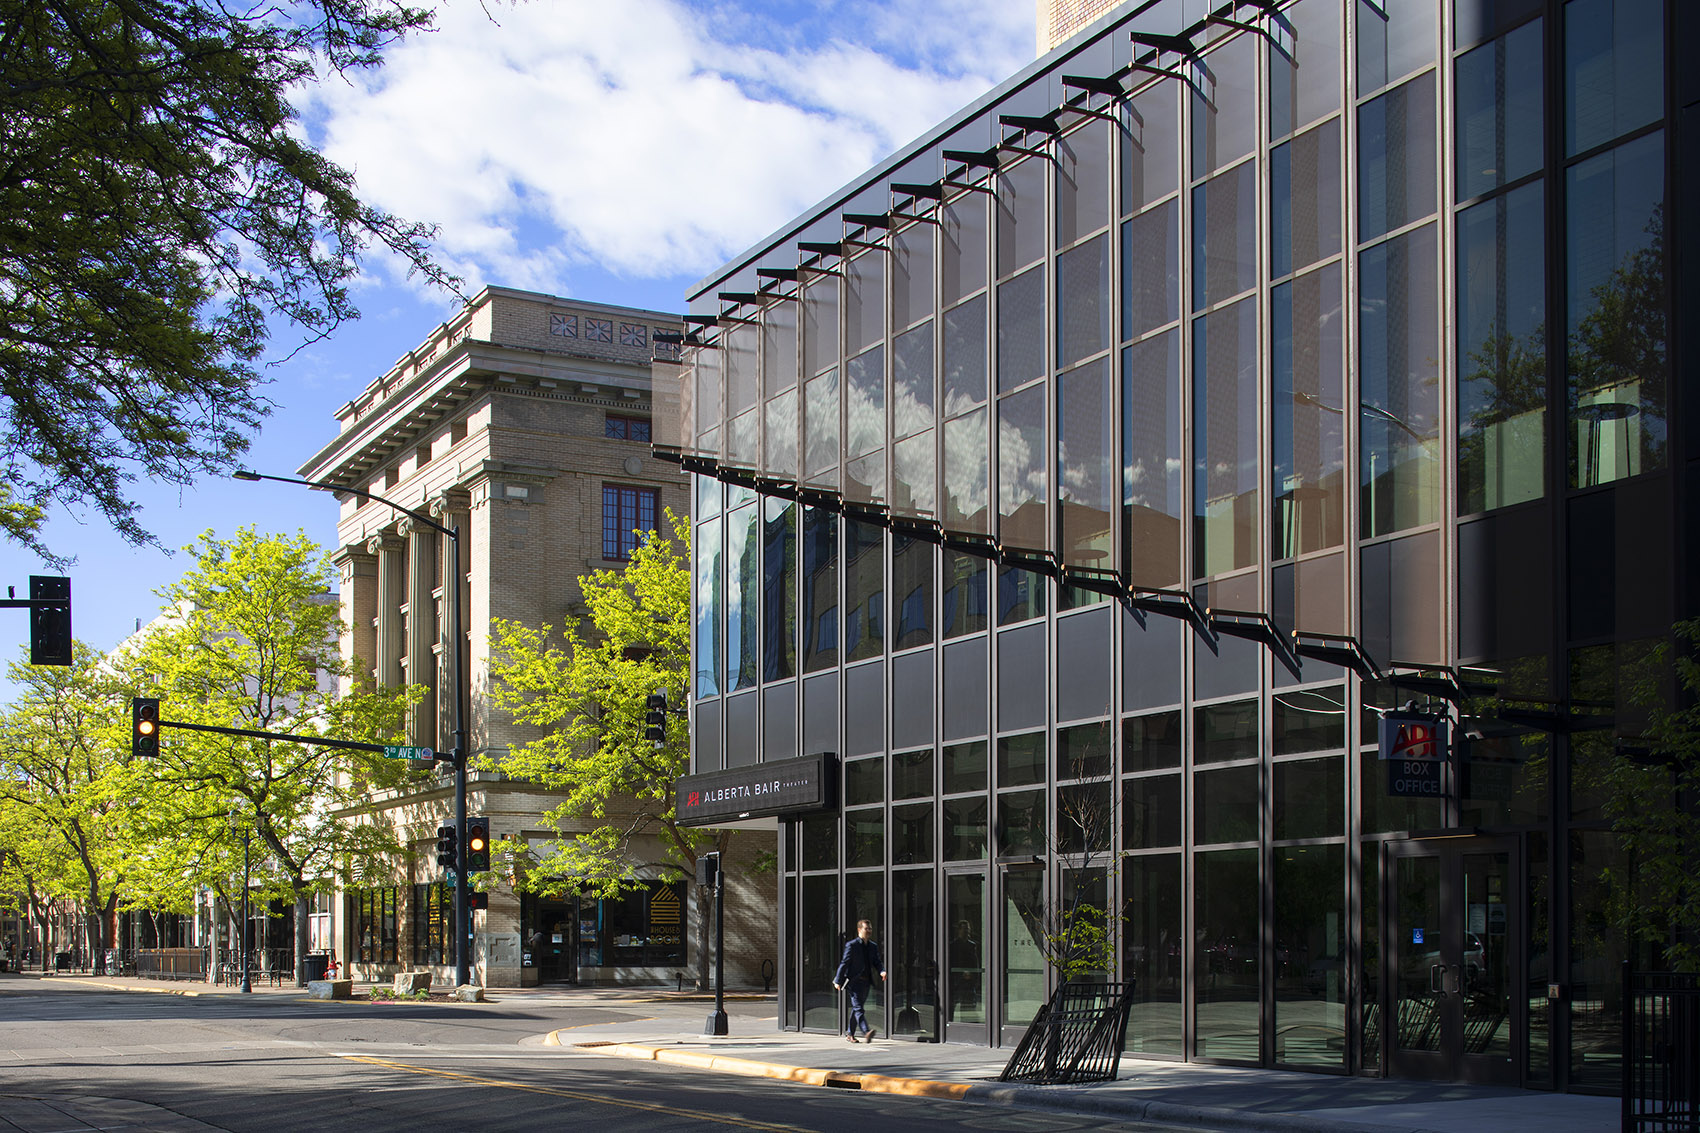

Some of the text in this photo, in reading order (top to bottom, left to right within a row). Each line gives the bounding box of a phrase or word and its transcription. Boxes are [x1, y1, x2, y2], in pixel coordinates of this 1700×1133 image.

[384, 746, 422, 759] 3RD AVE N
[1403, 762, 1430, 775] BOX
[704, 785, 751, 803] ALBERTA
[754, 780, 781, 796] BAIR
[1395, 779, 1438, 793] OFFICE
[655, 926, 675, 935] HOUSE
[650, 935, 680, 945] BOOKS
